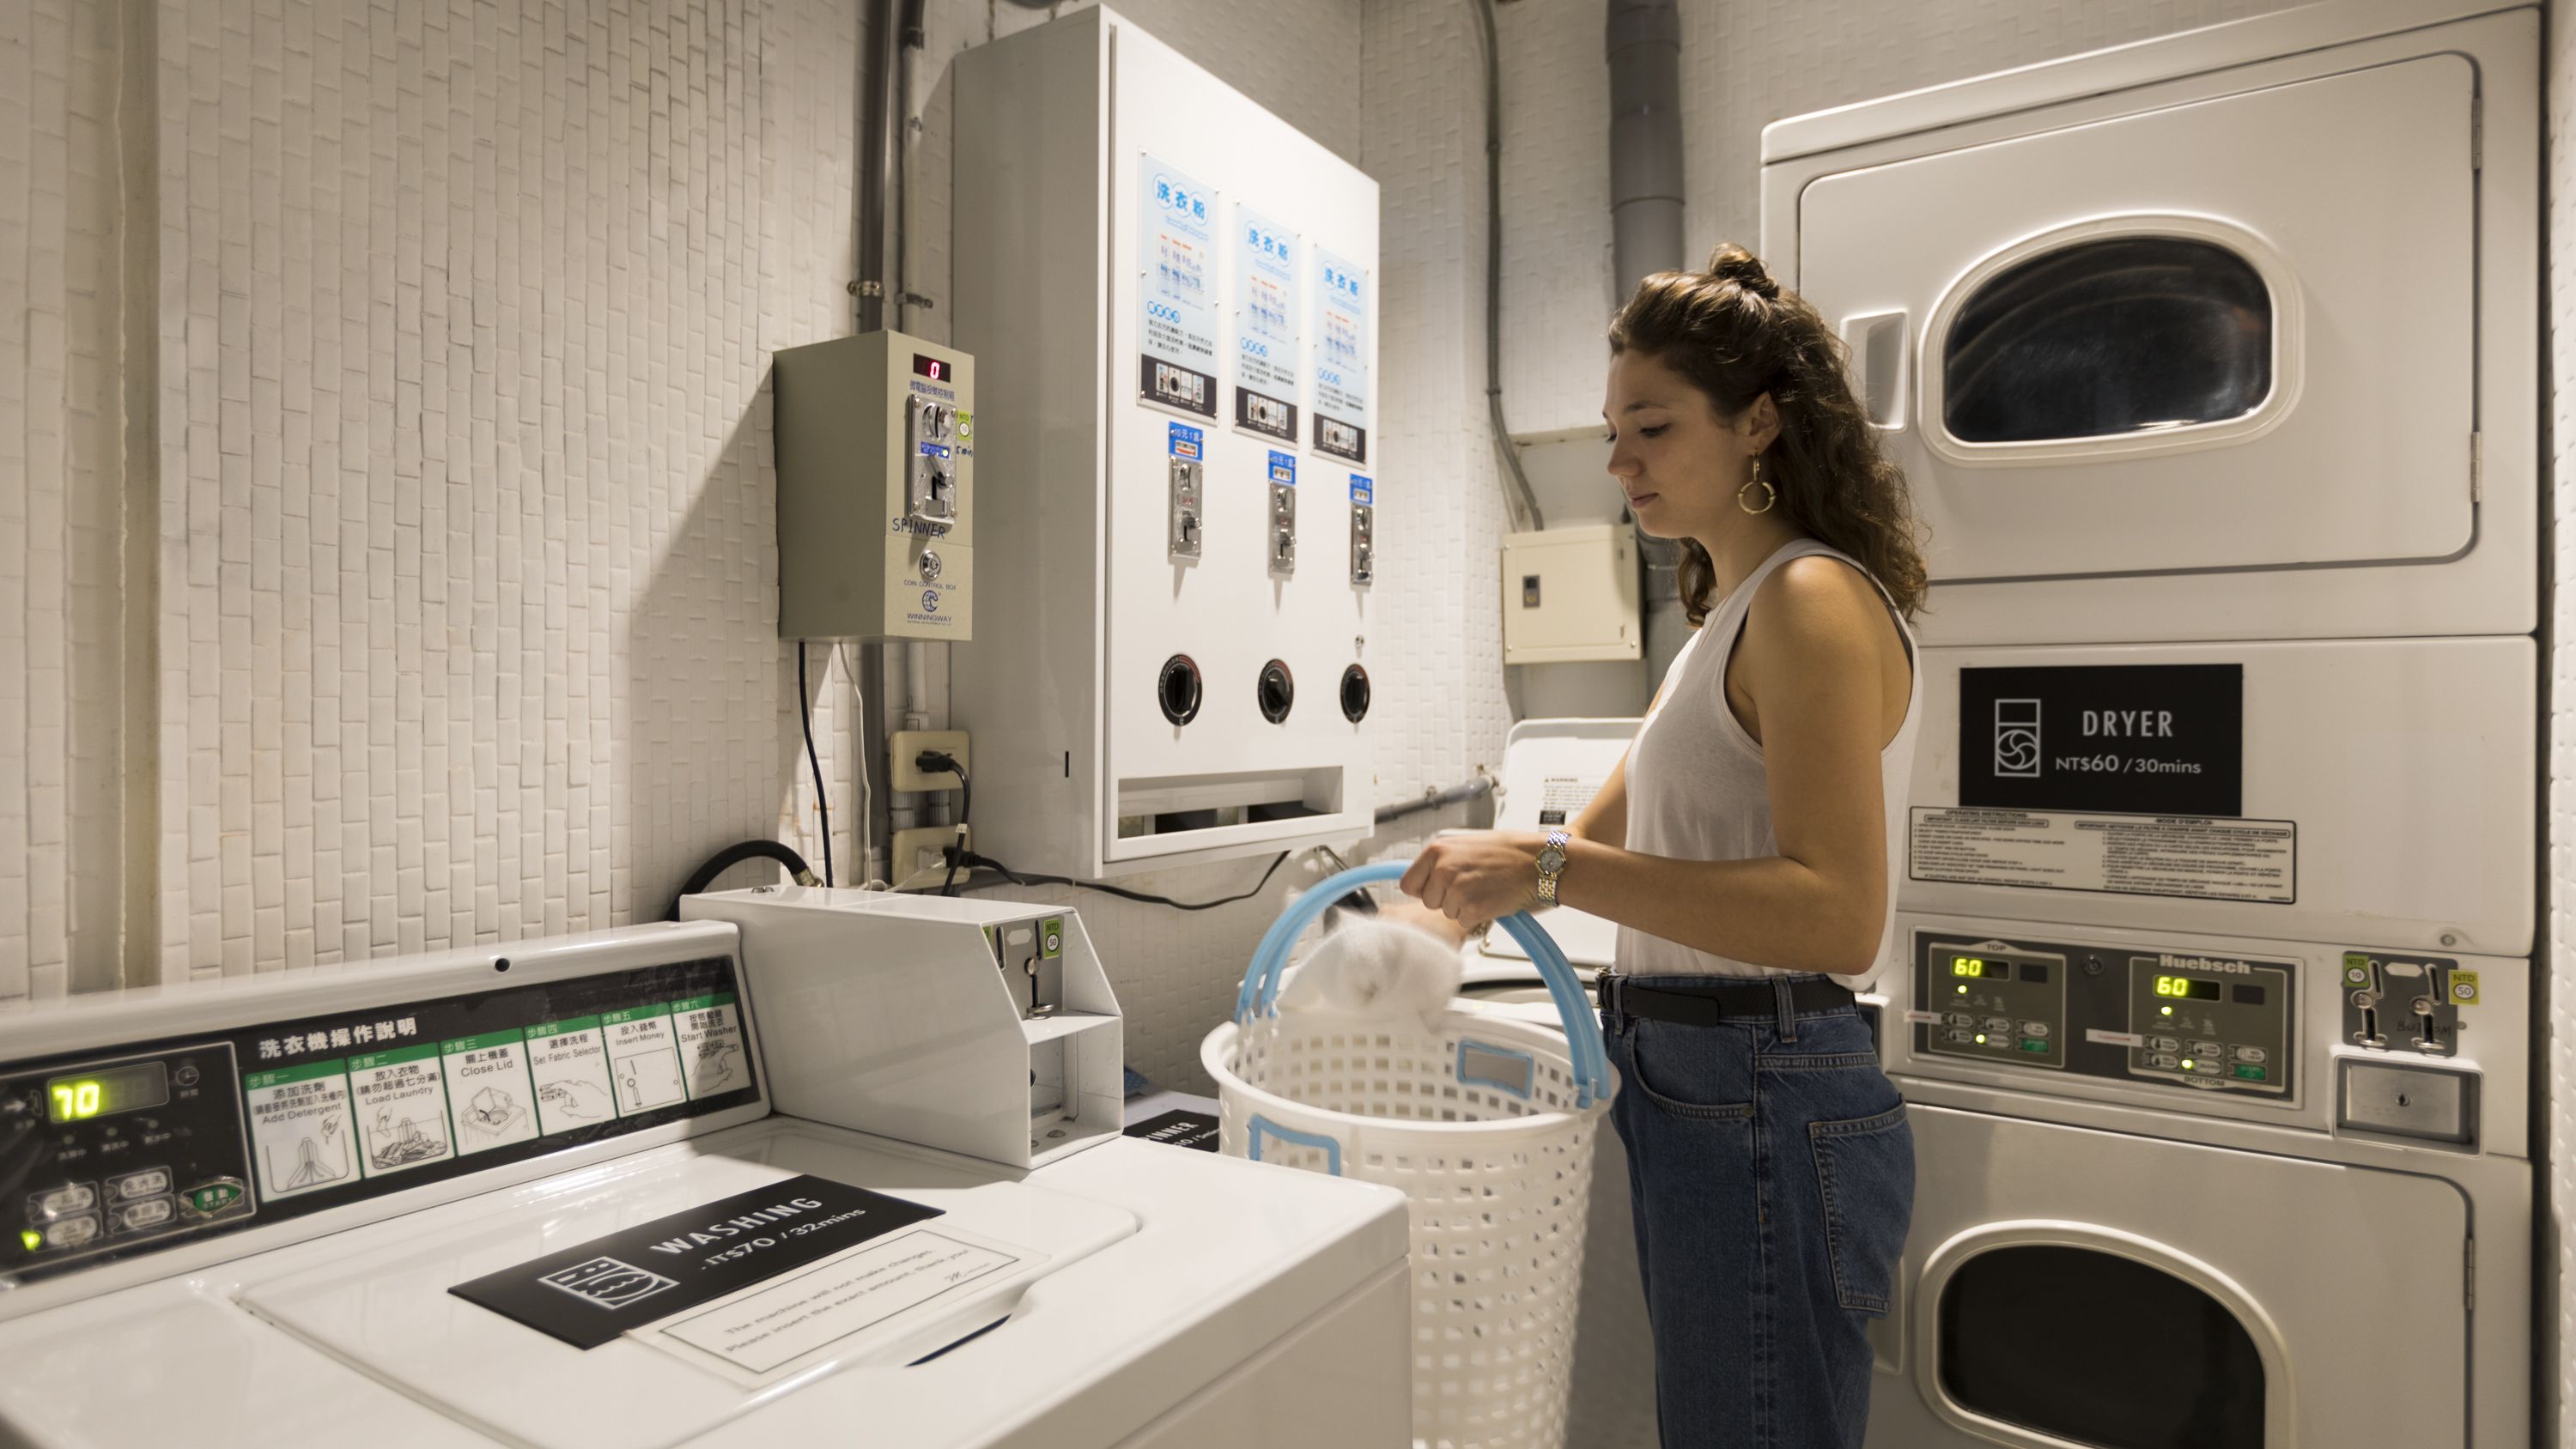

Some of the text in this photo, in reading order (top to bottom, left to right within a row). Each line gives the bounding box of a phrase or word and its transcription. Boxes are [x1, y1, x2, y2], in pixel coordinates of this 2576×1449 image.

[1157, 179, 1205, 220] 洗衣粉
[1249, 227, 1288, 261] 洗衣粉
[929, 361, 941, 379] 0
[892, 518, 946, 540] SPINNER
[919, 581, 944, 590] CONTROL
[907, 612, 952, 622] WINNINGWAY
[2082, 710, 2174, 737] DRYER
[2055, 755, 2119, 773] NT$60
[1047, 922, 1060, 931] NTD
[1049, 938, 1057, 947] 50
[1954, 958, 1983, 977] 60
[2159, 954, 2251, 975] Huebsch
[2346, 958, 2366, 967] NTD
[2349, 971, 2361, 979] 10
[2452, 973, 2476, 983] NTD
[2156, 976, 2189, 997] 60
[2457, 986, 2472, 996] 50
[604, 1011, 631, 1024] 步驟五
[258, 1016, 418, 1060] 洗衣機操作說明
[527, 1023, 557, 1039] 步驟四
[616, 1032, 665, 1046] Insert Money
[680, 1026, 737, 1043] Start Washer
[443, 1038, 477, 1054] 步驟三
[549, 1033, 590, 1049] 選擇洗程
[351, 1053, 389, 1070] 步驟二
[533, 1046, 602, 1065] Set Fabric Selector
[374, 1064, 420, 1082] 放入衣物
[460, 1058, 514, 1078] Close Lid
[248, 1073, 289, 1088] 步驟一
[2184, 1076, 2226, 1088] BOTTOM
[273, 1081, 326, 1100] 添加洗劑
[365, 1086, 434, 1106] Load Laundry
[52, 1082, 100, 1121] 70
[262, 1102, 342, 1125] Add Detergent
[648, 1197, 823, 1254] WASHING
[726, 1321, 755, 1335] The
[755, 1299, 808, 1325] machine
[810, 1288, 832, 1301] will
[833, 1280, 854, 1292] not
[855, 1266, 886, 1282] make
[726, 1331, 772, 1353] Please
[773, 1313, 807, 1332] insert
[809, 1303, 832, 1317] the
[834, 1289, 864, 1307] exact
[914, 1258, 945, 1272] thank
